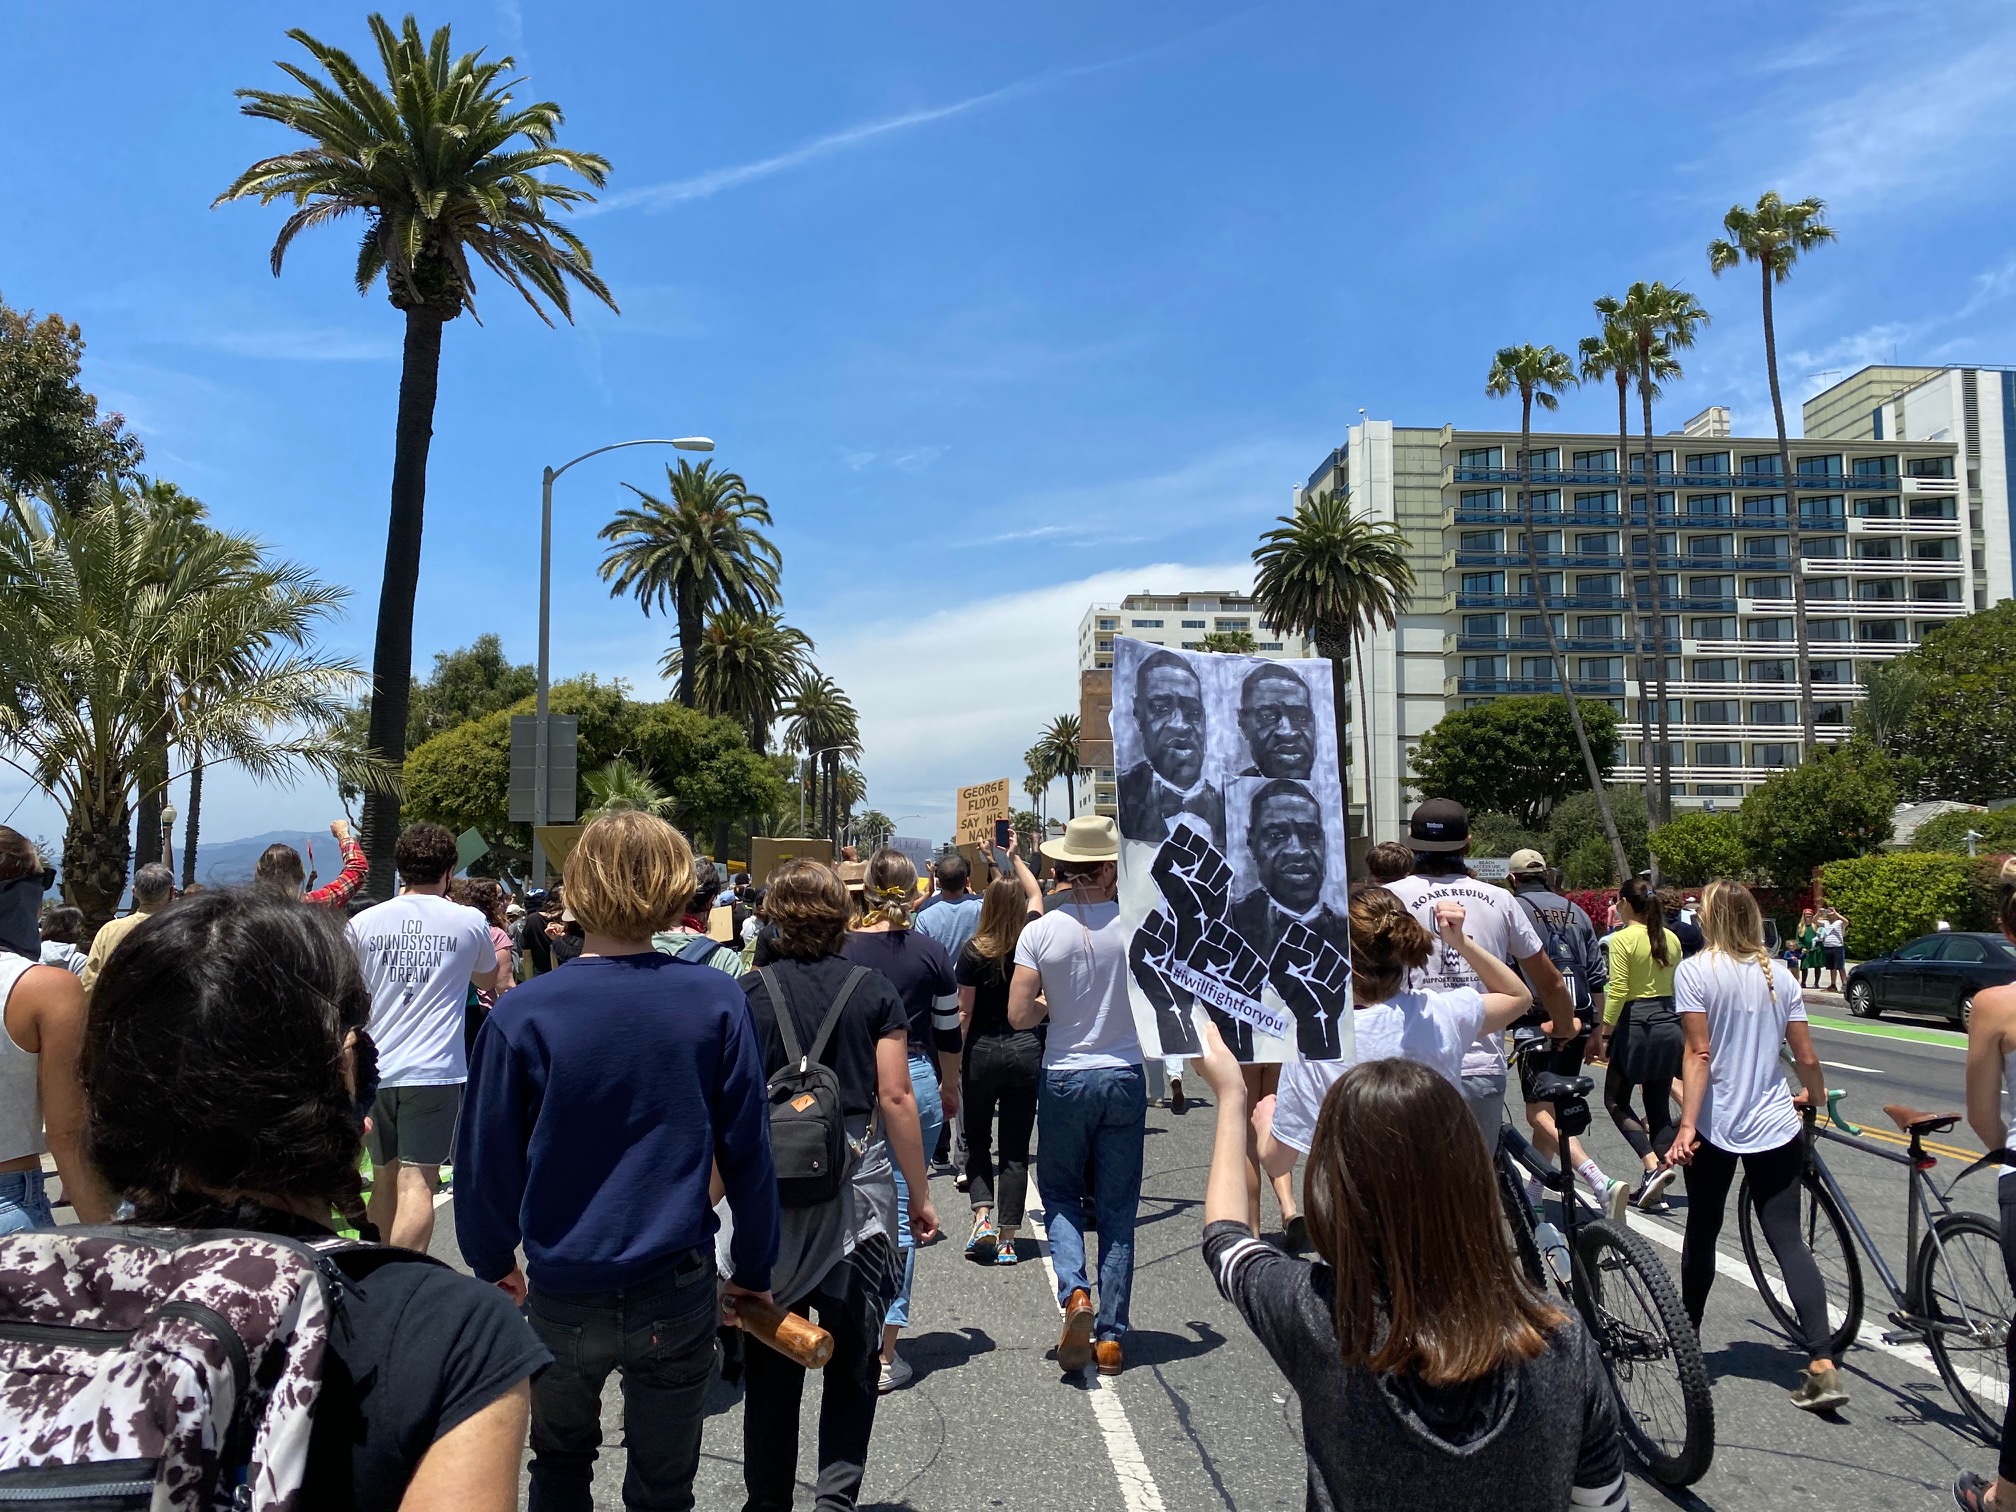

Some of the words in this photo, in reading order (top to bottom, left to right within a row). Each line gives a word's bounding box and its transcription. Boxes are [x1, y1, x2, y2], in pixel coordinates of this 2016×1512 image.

[963, 781, 1004, 799] GEORGE
[968, 795, 999, 811] FLOYD
[961, 817, 980, 829] SAY
[986, 812, 1003, 825] HIS
[968, 827, 996, 842] NAM
[892, 838, 924, 851] BLACK
[1411, 888, 1449, 910] ROARK
[1450, 888, 1496, 907] REVIVAL
[1533, 909, 1578, 925] PEREZ
[401, 919, 423, 935] LCD
[369, 935, 458, 953] SOUNDSYSTEM
[381, 951, 442, 967] AMERICAN
[389, 966, 430, 983] DREAM
[1422, 976, 1450, 984] SUPPORT
[1172, 967, 1284, 1032] #iwillfightforyou
